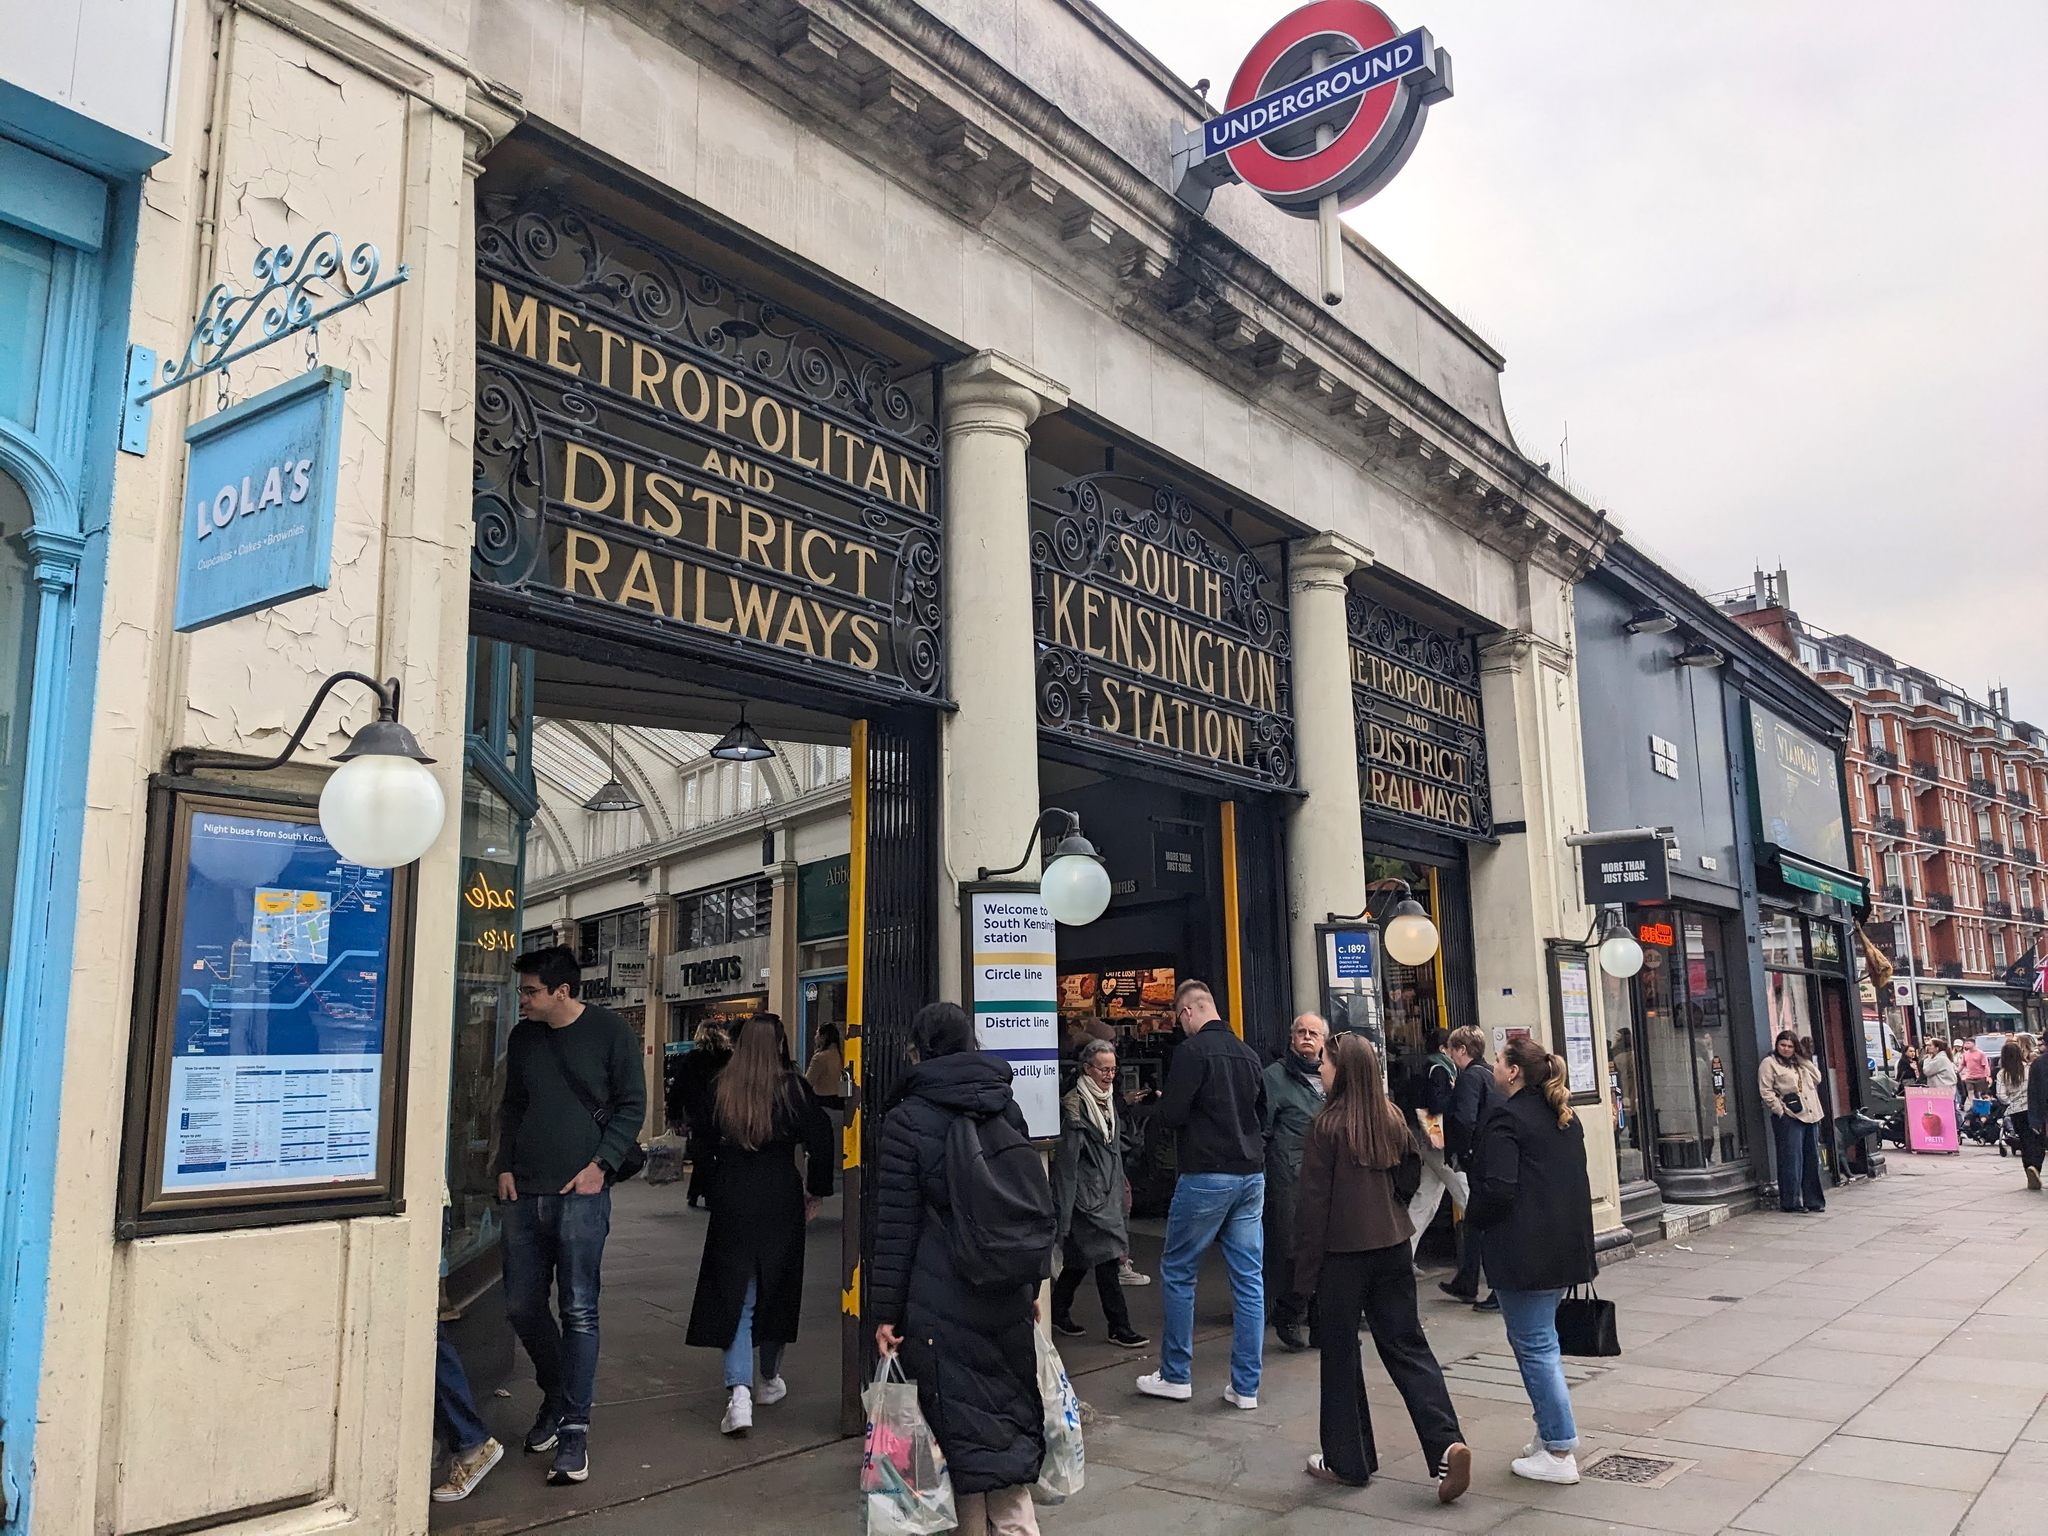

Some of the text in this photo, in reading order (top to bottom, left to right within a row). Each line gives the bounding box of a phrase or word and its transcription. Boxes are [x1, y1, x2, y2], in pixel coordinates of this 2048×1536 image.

[1212, 44, 1413, 145] UNDERGROUND
[491, 281, 926, 511] METROPOLITAN
[702, 447, 775, 494] AND
[197, 459, 313, 541] LOLA'S
[563, 440, 878, 598] DISTRICT
[197, 524, 305, 570] Cupcakes Cakes Brownies
[1120, 532, 1222, 622] SOUTH
[564, 527, 879, 671] RAILWAYS
[1053, 574, 1276, 714] KENSINGTON
[1102, 677, 1245, 767] STATION
[1405, 712, 1429, 732] AND
[1369, 722, 1467, 785] DISTRICT
[1372, 769, 1471, 827] RAILWAYS
[203, 823, 228, 834] Night
[230, 826, 255, 836] buses
[256, 828, 276, 839] from
[278, 831, 301, 840] South
[1165, 851, 1192, 863] MORE THAN
[1166, 862, 1178, 872] JUST
[1601, 860, 1646, 873] MORE THAN
[1603, 871, 1648, 884] JUST SUBS.
[984, 904, 1048, 916] Welcome to
[984, 918, 1020, 929] South
[984, 932, 1028, 943] station
[1347, 944, 1366, 953] 1892
[680, 955, 742, 987] TREATS
[985, 968, 1042, 980] Circle line
[985, 1016, 1049, 1028] District line
[1043, 1064, 1056, 1075] line
